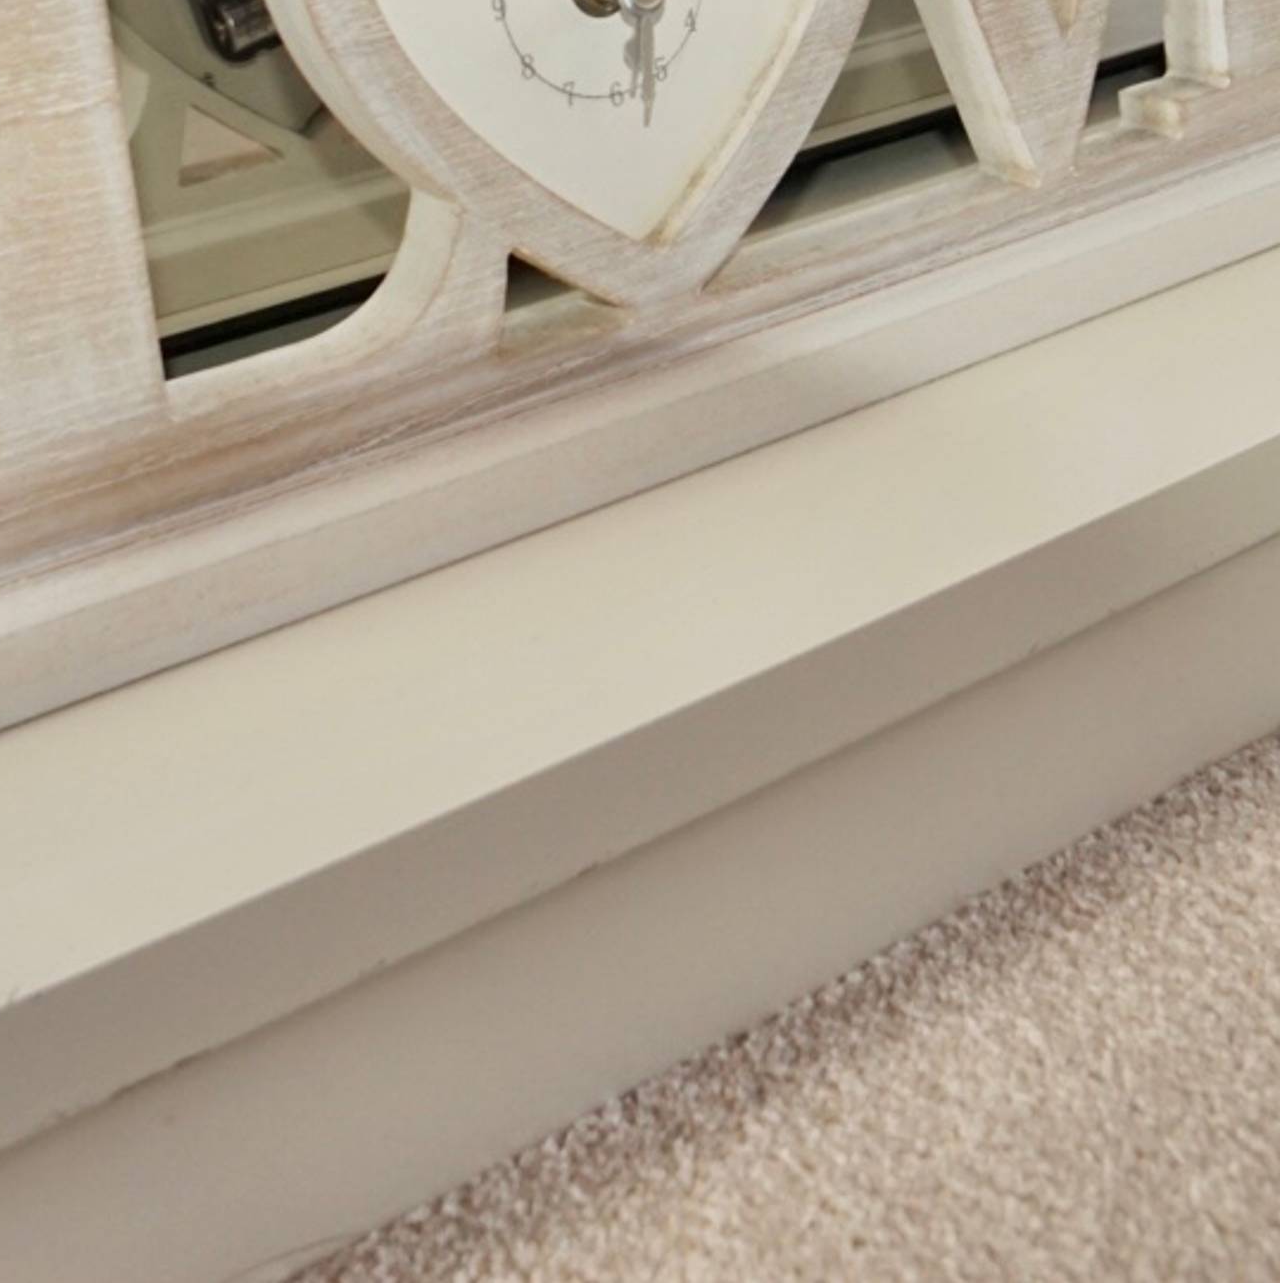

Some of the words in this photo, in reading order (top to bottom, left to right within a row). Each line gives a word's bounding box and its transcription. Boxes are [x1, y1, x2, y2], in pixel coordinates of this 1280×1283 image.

[684, 8, 696, 33] 4
[520, 54, 536, 80] 8
[652, 56, 668, 81] 5
[562, 81, 575, 106] 7
[609, 82, 624, 106] 6
